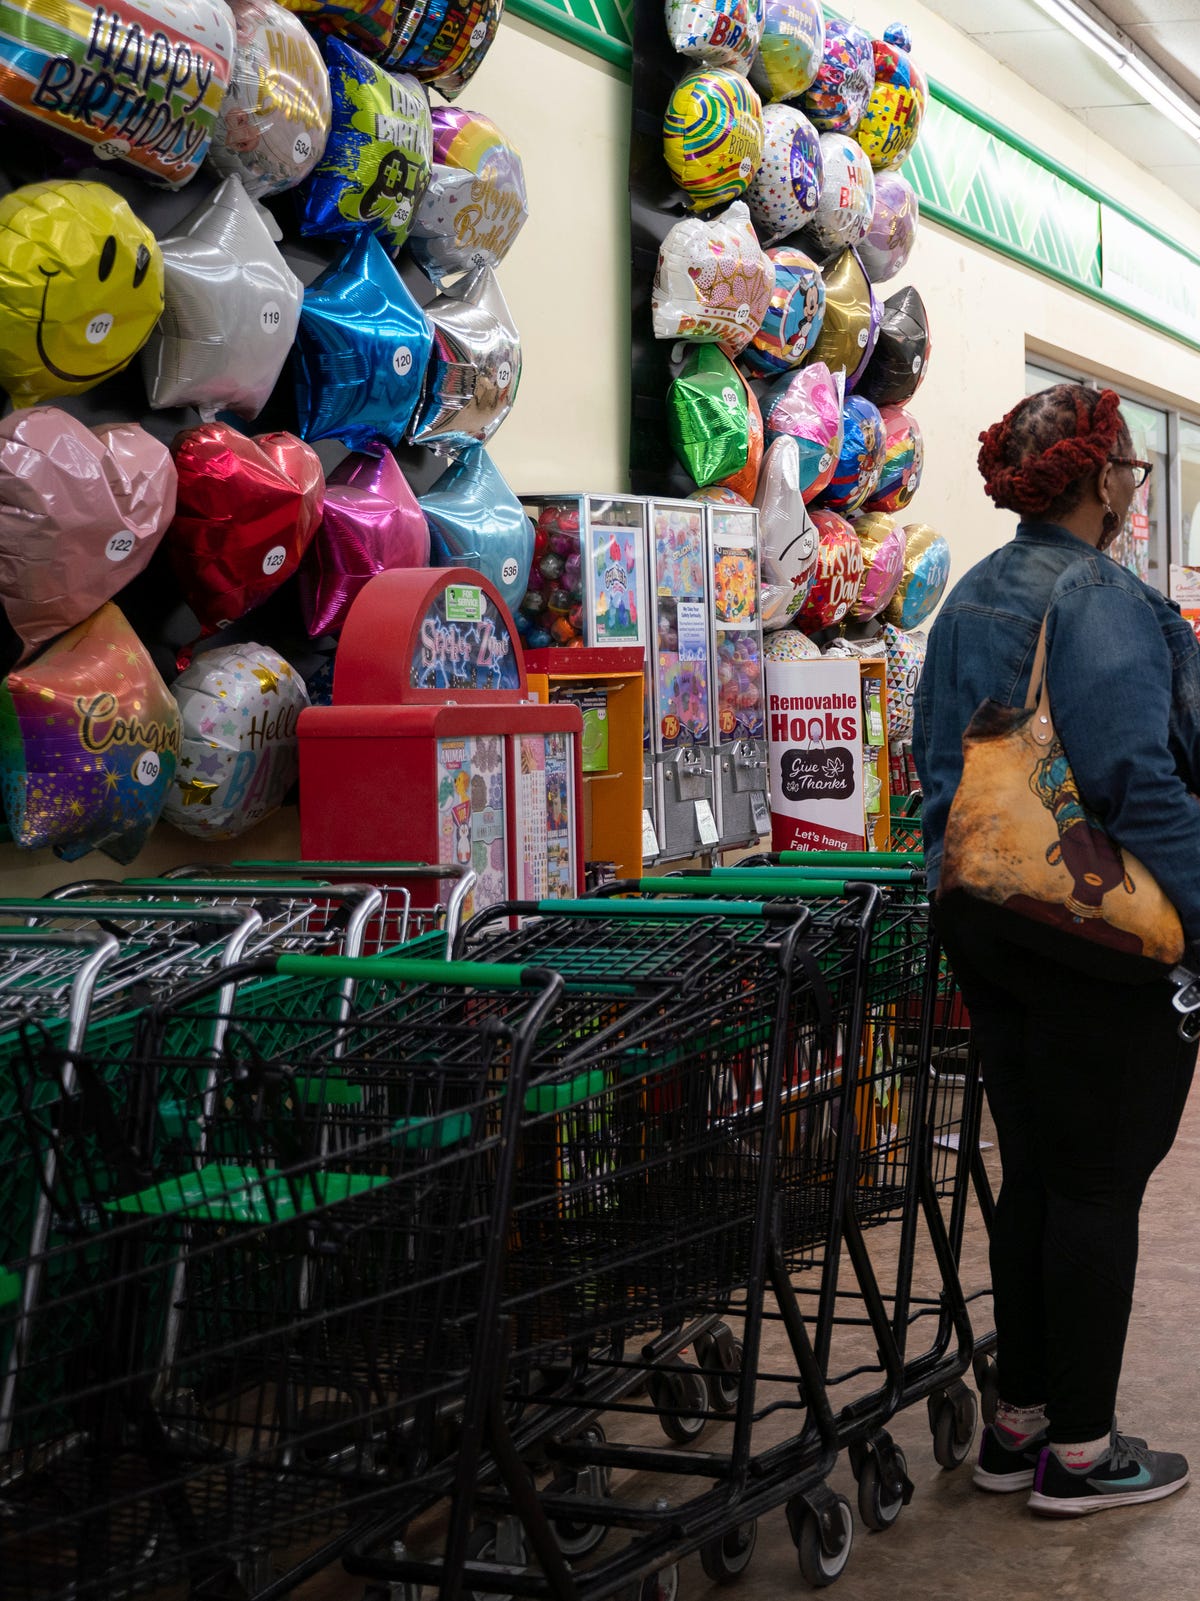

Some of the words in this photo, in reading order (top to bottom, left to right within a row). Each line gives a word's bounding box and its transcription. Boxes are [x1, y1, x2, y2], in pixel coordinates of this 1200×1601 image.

[471, 29, 486, 38] 284
[86, 6, 216, 113] HAPPY
[32, 56, 209, 170] BIRTHDAY!
[101, 142, 125, 158] 532
[294, 142, 309, 157] 534
[470, 163, 523, 230] Happy
[394, 207, 410, 222] 535
[262, 312, 280, 324] 119
[737, 309, 748, 319] 127
[90, 320, 110, 333] 101
[395, 354, 411, 368] 120
[498, 370, 510, 381] 121
[723, 393, 737, 403] 199
[109, 540, 133, 552] 122
[266, 554, 285, 568] 123
[502, 565, 517, 578] 536
[462, 590, 473, 598] FOR
[457, 598, 479, 607] SERVICE
[770, 693, 857, 711] Removable
[771, 712, 857, 742] Hooks
[441, 749, 465, 764] ANIMAL
[141, 759, 159, 778] 109
[789, 757, 820, 778] Give
[799, 774, 847, 790] Thanks
[795, 827, 820, 842] Let's
[821, 834, 848, 850] hang
